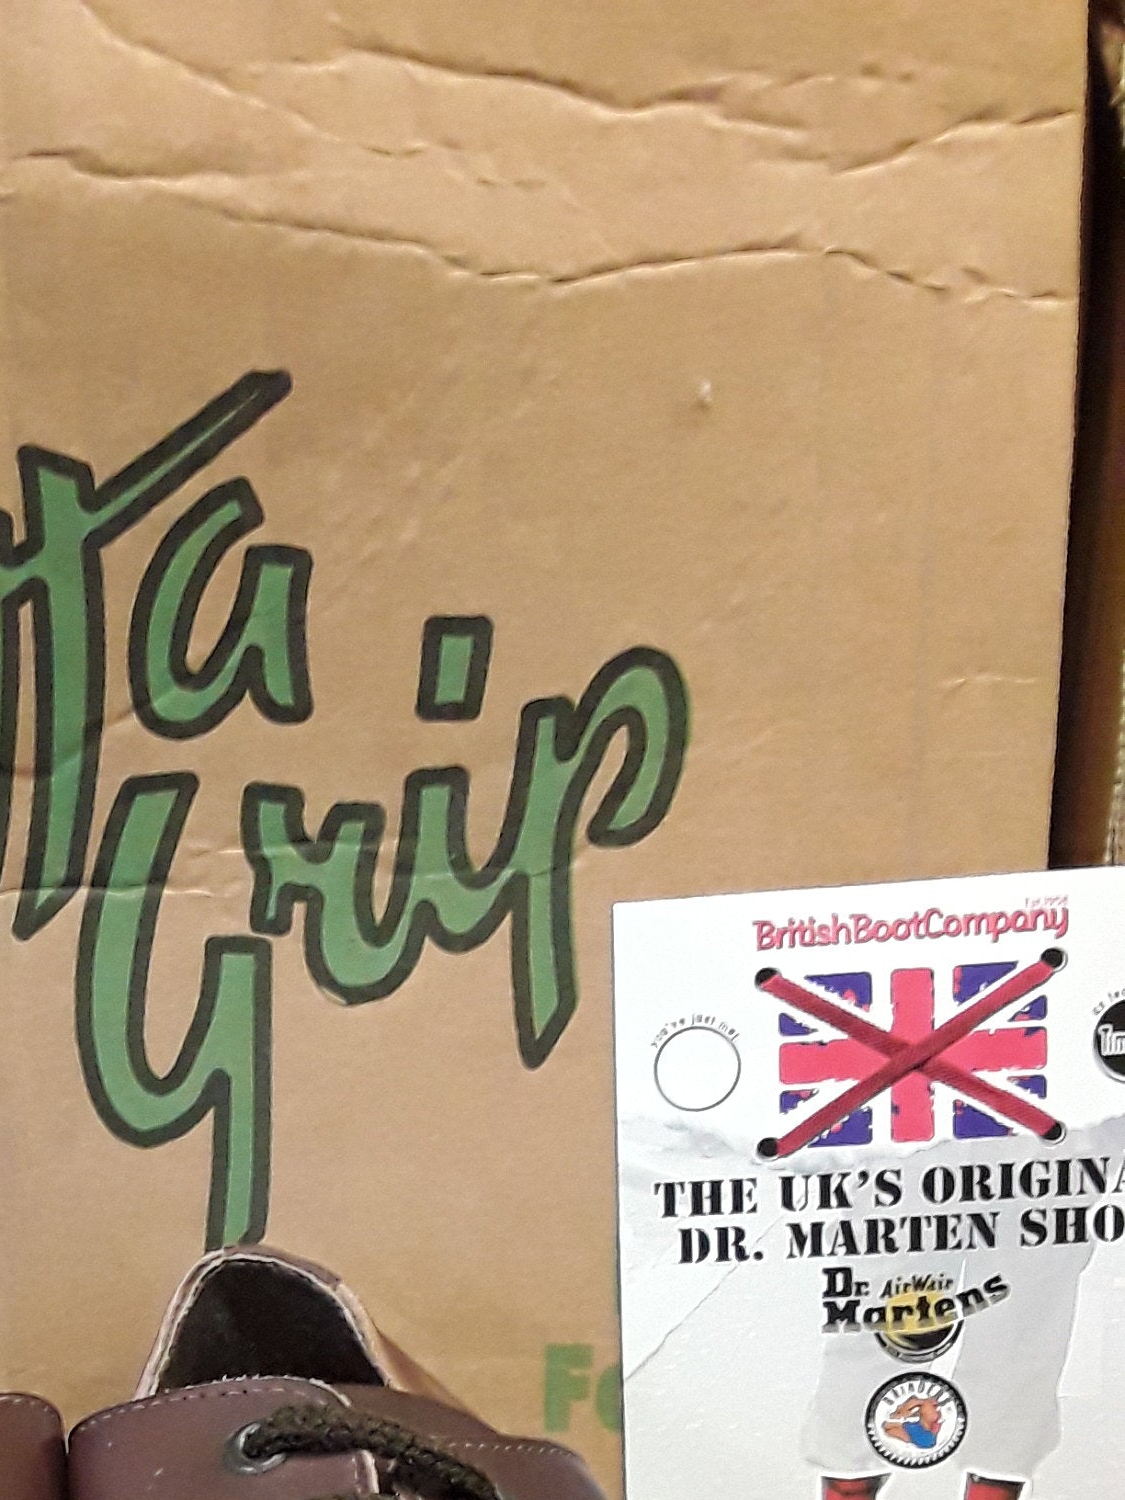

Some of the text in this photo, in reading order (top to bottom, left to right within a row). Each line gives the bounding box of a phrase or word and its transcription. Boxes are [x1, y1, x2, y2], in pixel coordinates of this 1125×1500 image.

[75, 615, 689, 1252] Grip
[753, 906, 1069, 951] BritishBootCompany
[655, 1177, 758, 1218] THE
[780, 1168, 903, 1210] UK'S
[679, 1226, 764, 1264] DR.
[785, 1211, 998, 1259] MARTEN
[821, 1274, 1011, 1334] Martens
[822, 1267, 870, 1299] Dr.
[879, 1273, 954, 1300] AirWair
